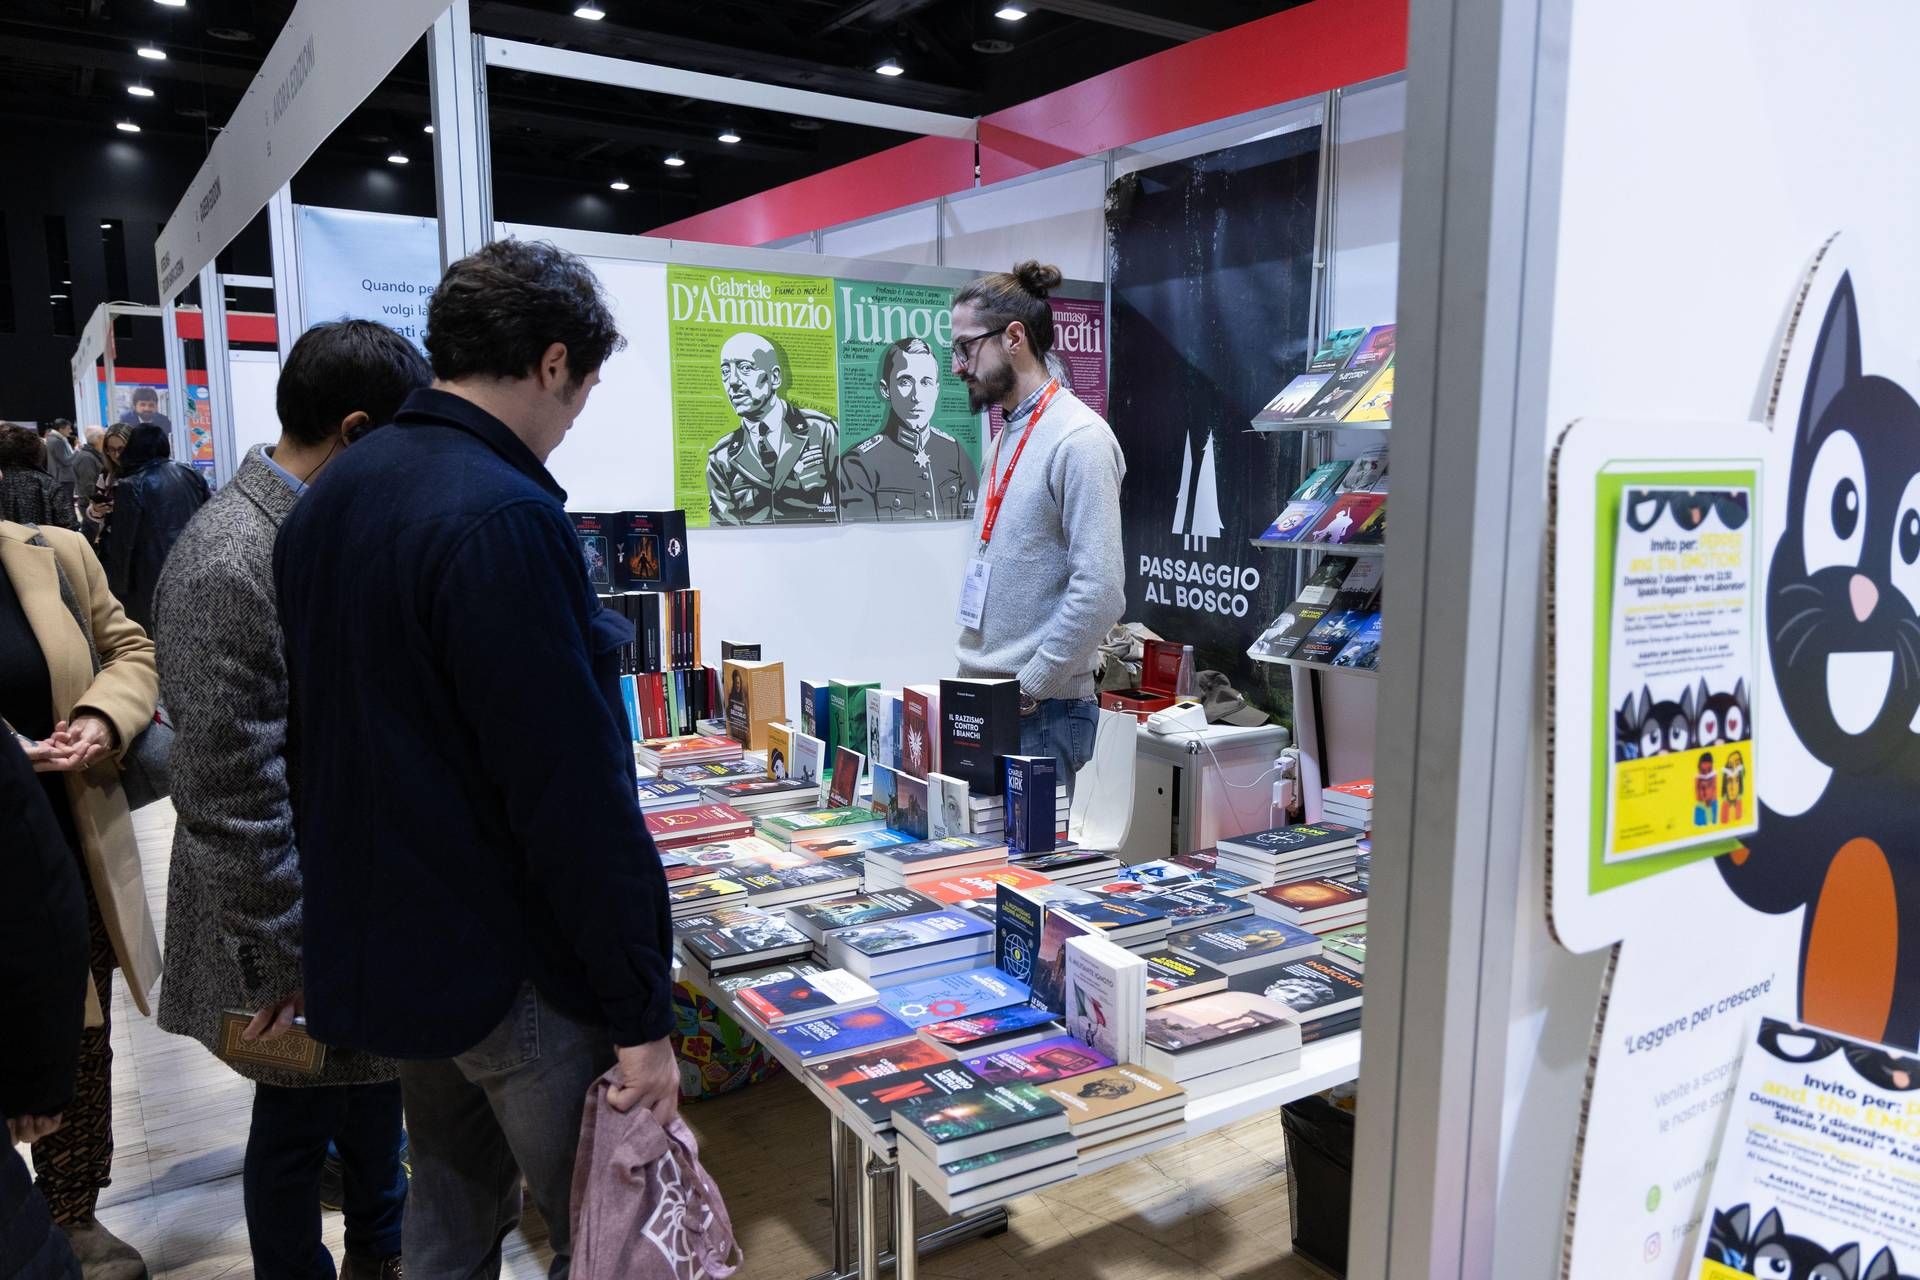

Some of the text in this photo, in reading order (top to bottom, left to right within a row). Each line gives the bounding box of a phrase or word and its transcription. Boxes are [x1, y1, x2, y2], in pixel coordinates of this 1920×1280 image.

[362, 279, 434, 296] Quando pe
[710, 275, 772, 300] Gabriele
[382, 304, 414, 317] volgi
[672, 283, 831, 331] D'Annunzio
[840, 286, 952, 347] Jünge
[1052, 312, 1087, 323] mmaso
[1050, 318, 1103, 353] netti
[1651, 537, 1676, 551] Invito
[1139, 555, 1260, 591] PASSAGGIO
[1145, 582, 1249, 617] AL BOSCO
[949, 713, 984, 725] IL RAZZISMO
[954, 722, 979, 731] CONTRO
[957, 729, 981, 739] BIANCHI
[1008, 775, 1023, 791] KIRK
[1305, 960, 1363, 988] INDECENT
[1625, 973, 1775, 1055] 'Leggere per crescere'
[1654, 1080, 1691, 1109] Venite
[1762, 1081, 1807, 1103] and
[1817, 1094, 1857, 1117] the
[1804, 1073, 1857, 1099] Invito
[1862, 1094, 1902, 1115] per:
[1672, 1101, 1708, 1124] nostre
[1749, 1092, 1815, 1119] Domenica
[1819, 1114, 1825, 1122] 7
[1829, 1117, 1895, 1144] dicembre
[1775, 1110, 1816, 1131] Spazio
[1821, 1125, 1874, 1149] Ragazzi
[1769, 1173, 1805, 1191] Adatto
[1809, 1187, 1827, 1197] per
[1832, 1194, 1877, 1214] bambini
